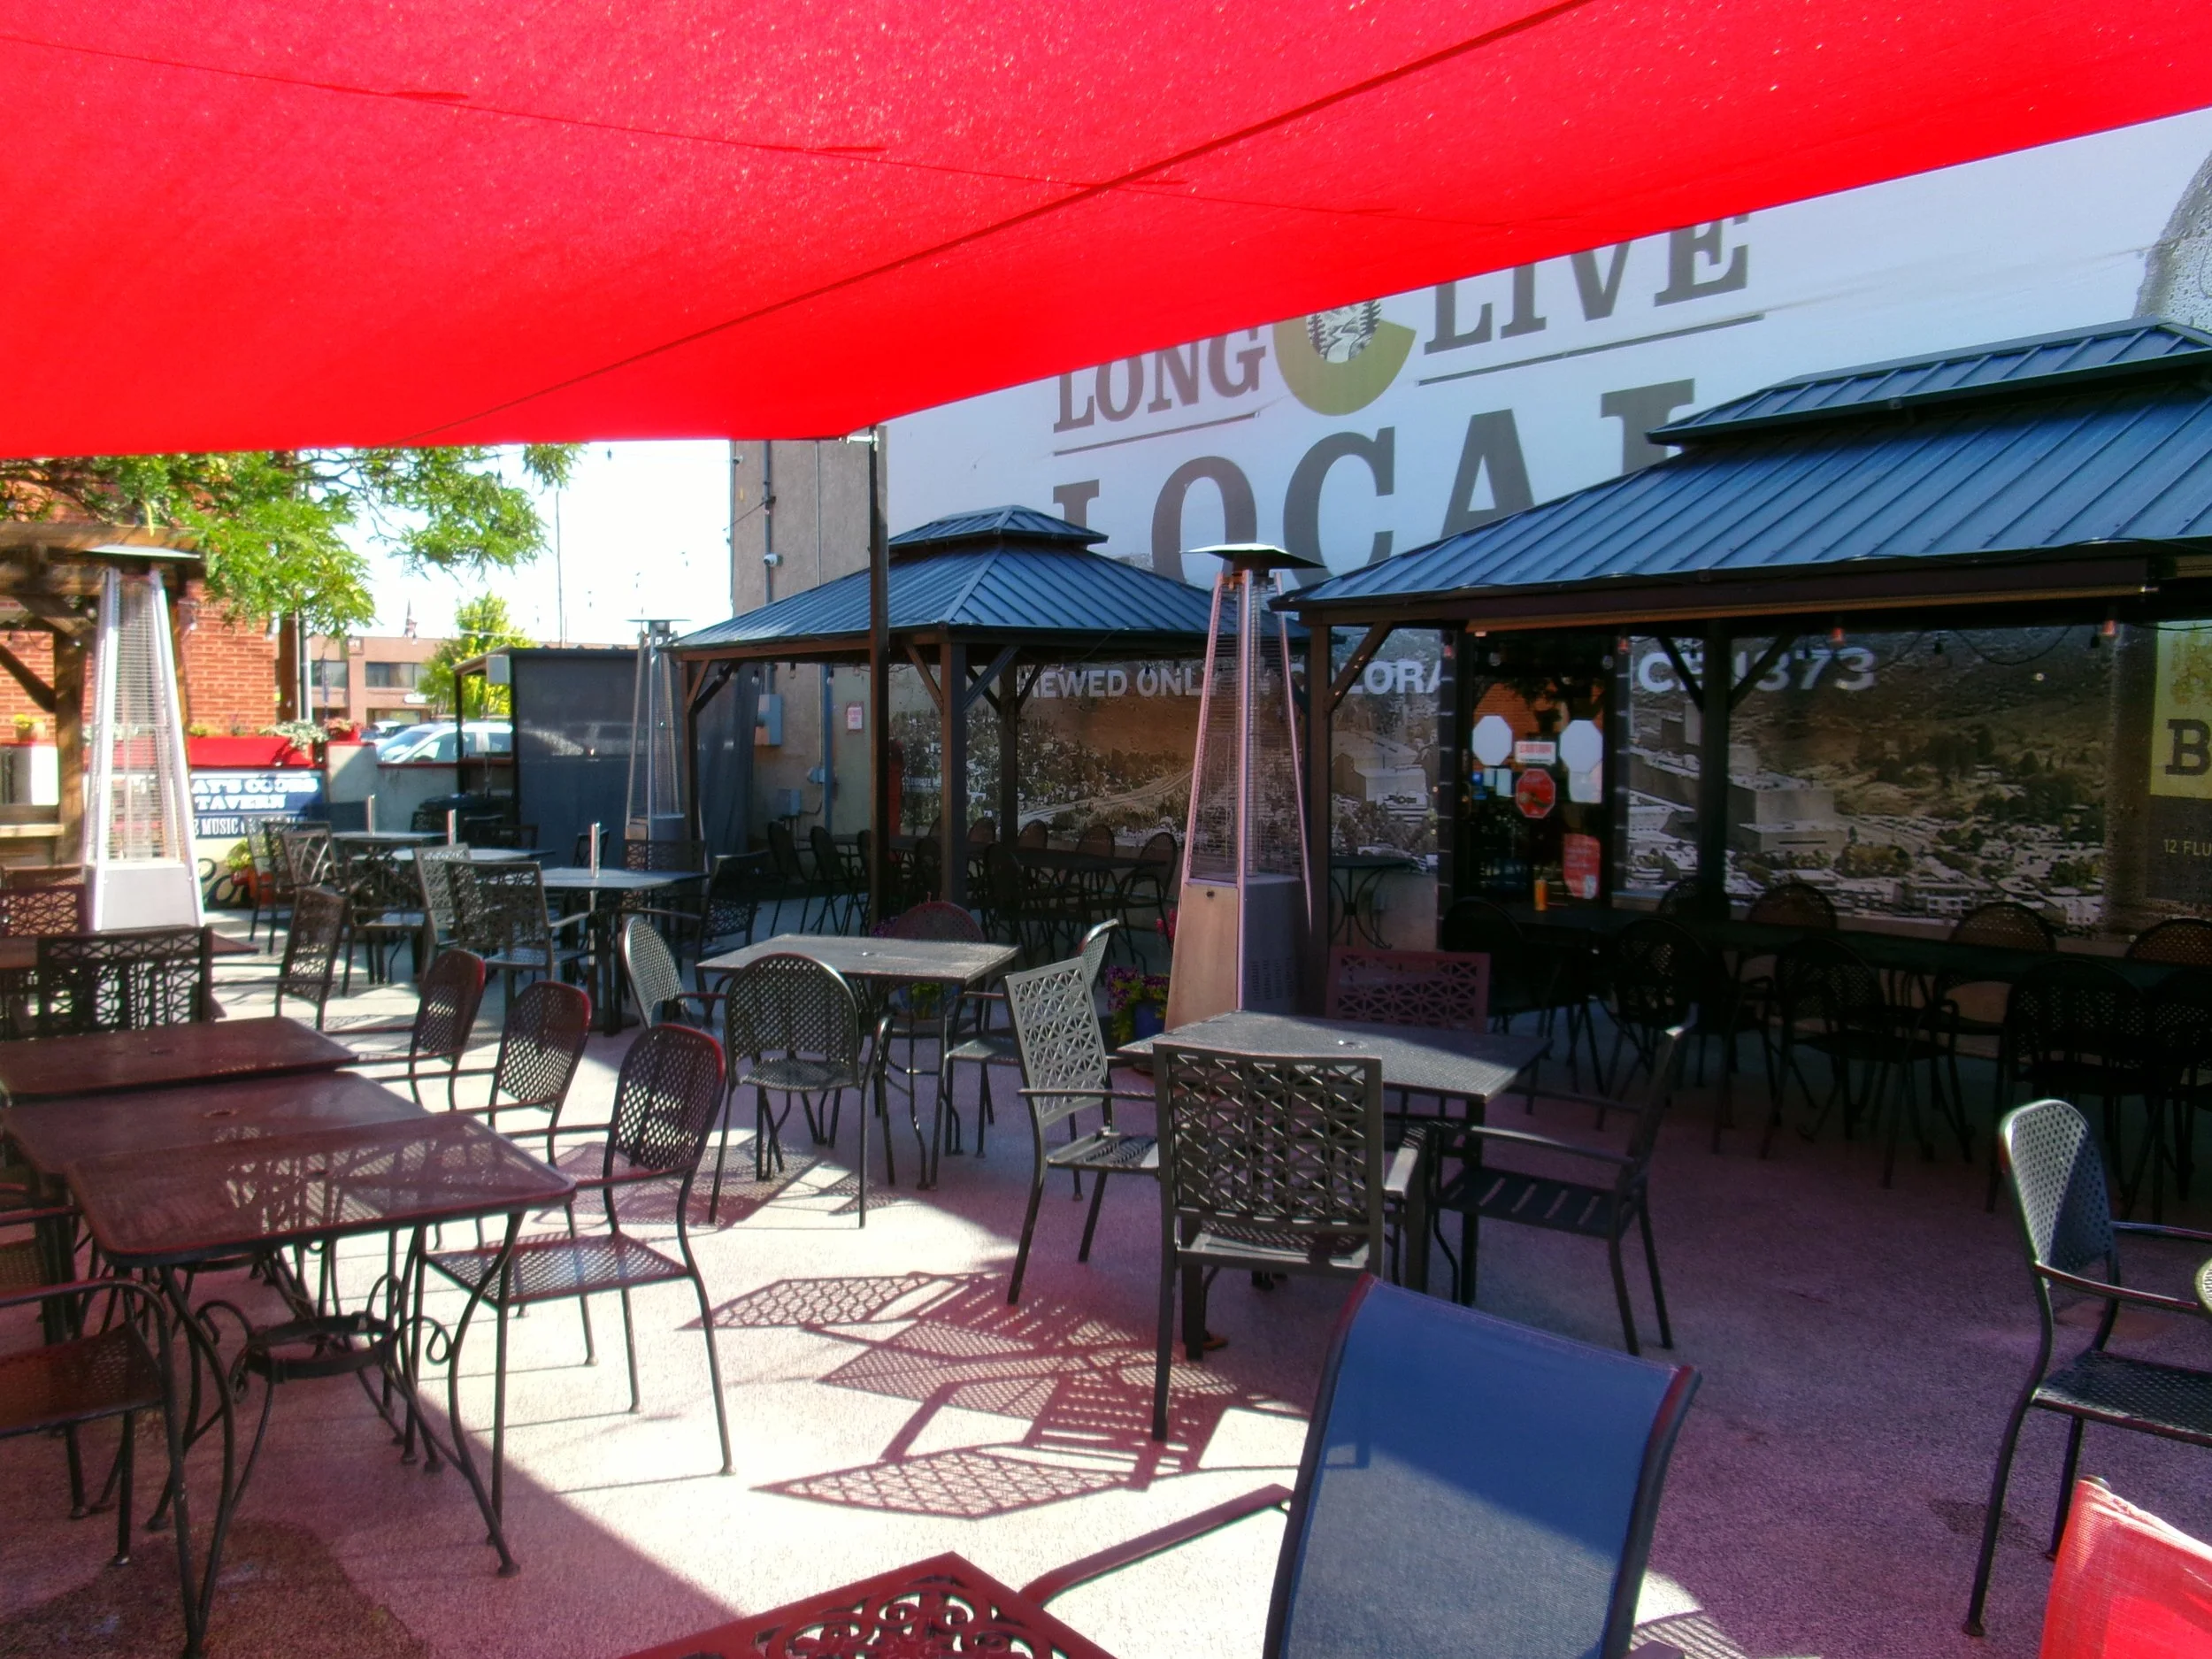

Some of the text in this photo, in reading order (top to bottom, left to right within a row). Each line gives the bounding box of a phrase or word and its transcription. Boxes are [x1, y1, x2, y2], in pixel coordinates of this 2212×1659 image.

[1054, 214, 1749, 433] LONG LIVE
[194, 794, 287, 810] TAVERN
[202, 817, 238, 836] MUSIC
